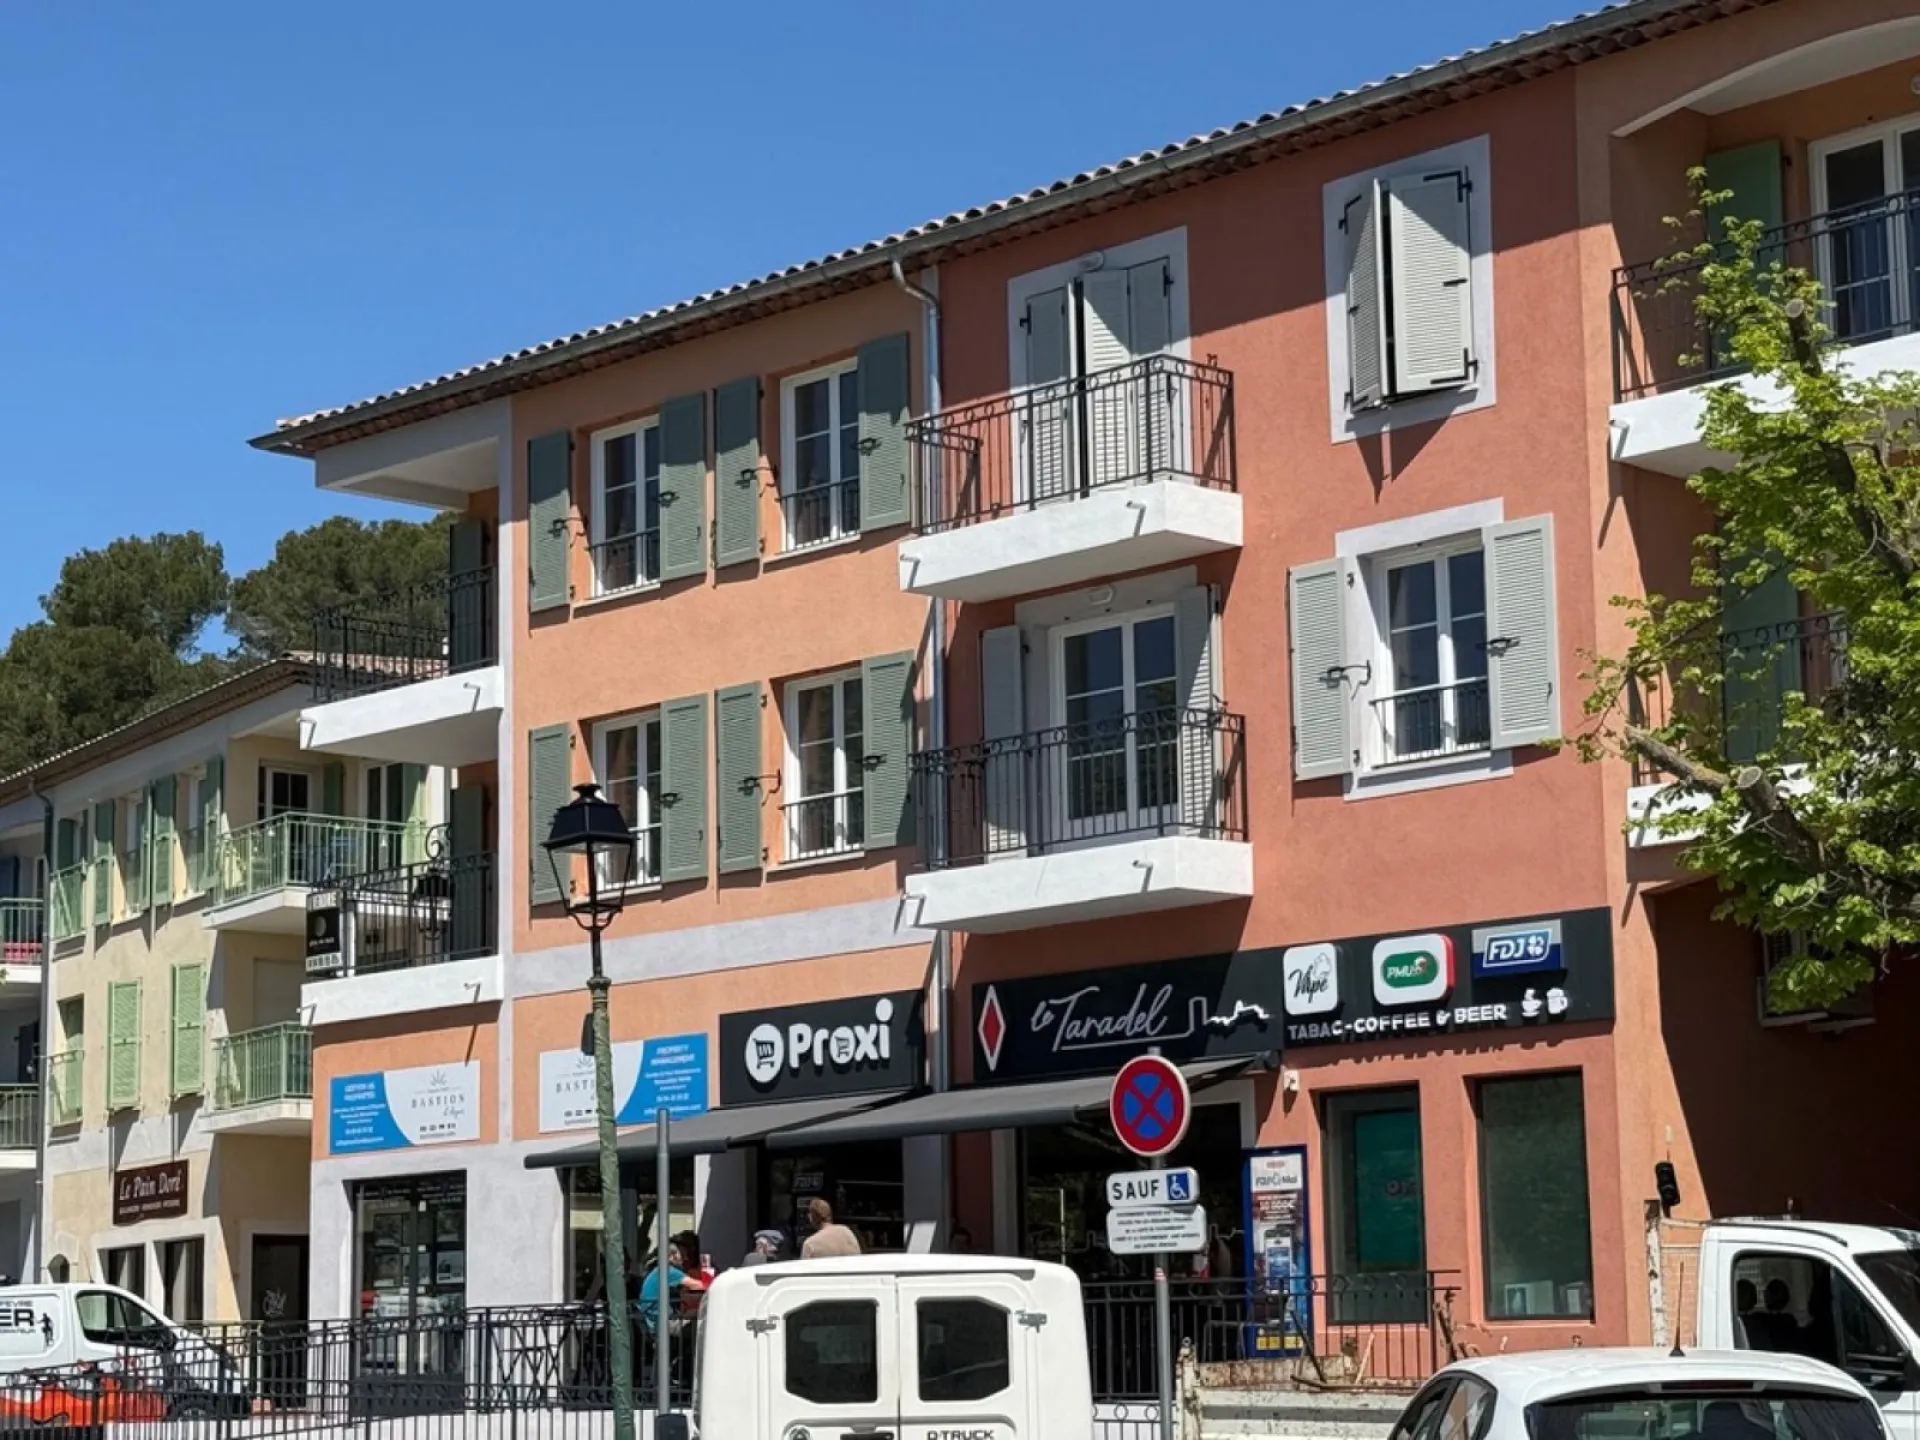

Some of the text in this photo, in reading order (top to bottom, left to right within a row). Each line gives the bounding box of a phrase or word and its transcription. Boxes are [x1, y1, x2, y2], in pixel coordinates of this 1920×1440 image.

[1488, 937, 1525, 960] FDJ
[1288, 963, 1328, 1004] Vape
[1386, 964, 1413, 980] PMU
[1048, 982, 1173, 1052] Taradel
[1436, 1009, 1451, 1027] &
[1454, 1003, 1508, 1024] BEER
[788, 998, 894, 1068] Proxi
[411, 1093, 465, 1109] BASTION
[119, 1177, 131, 1201] Le
[133, 1175, 156, 1198] Pain
[1111, 1178, 1160, 1201] SAUF
